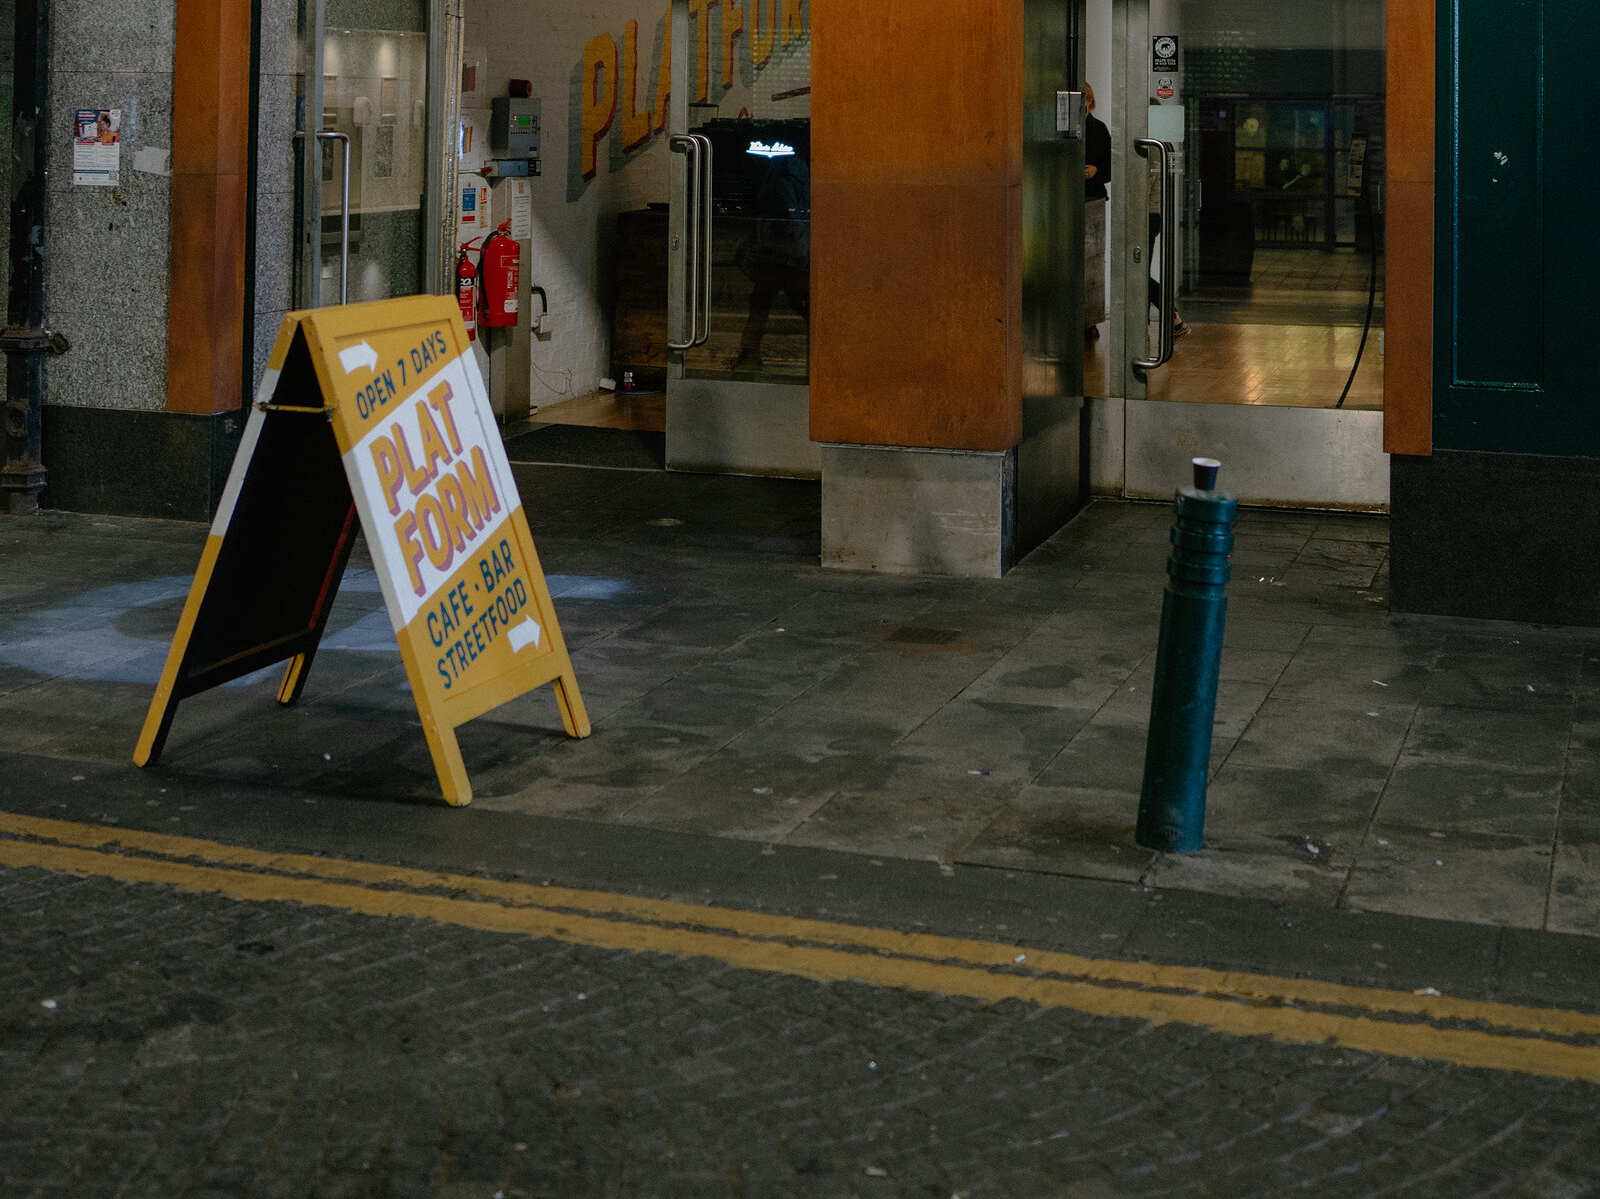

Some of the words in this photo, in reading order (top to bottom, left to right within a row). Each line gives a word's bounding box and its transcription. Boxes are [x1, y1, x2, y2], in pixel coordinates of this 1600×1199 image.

[356, 369, 396, 419] OPEN
[397, 358, 406, 387] 7
[410, 330, 447, 374] DAYS
[369, 379, 464, 517] PLAT
[394, 444, 501, 597] FORM
[427, 580, 474, 647] CAFE
[479, 539, 515, 593] BAR
[437, 577, 527, 689] STREETFOOD
